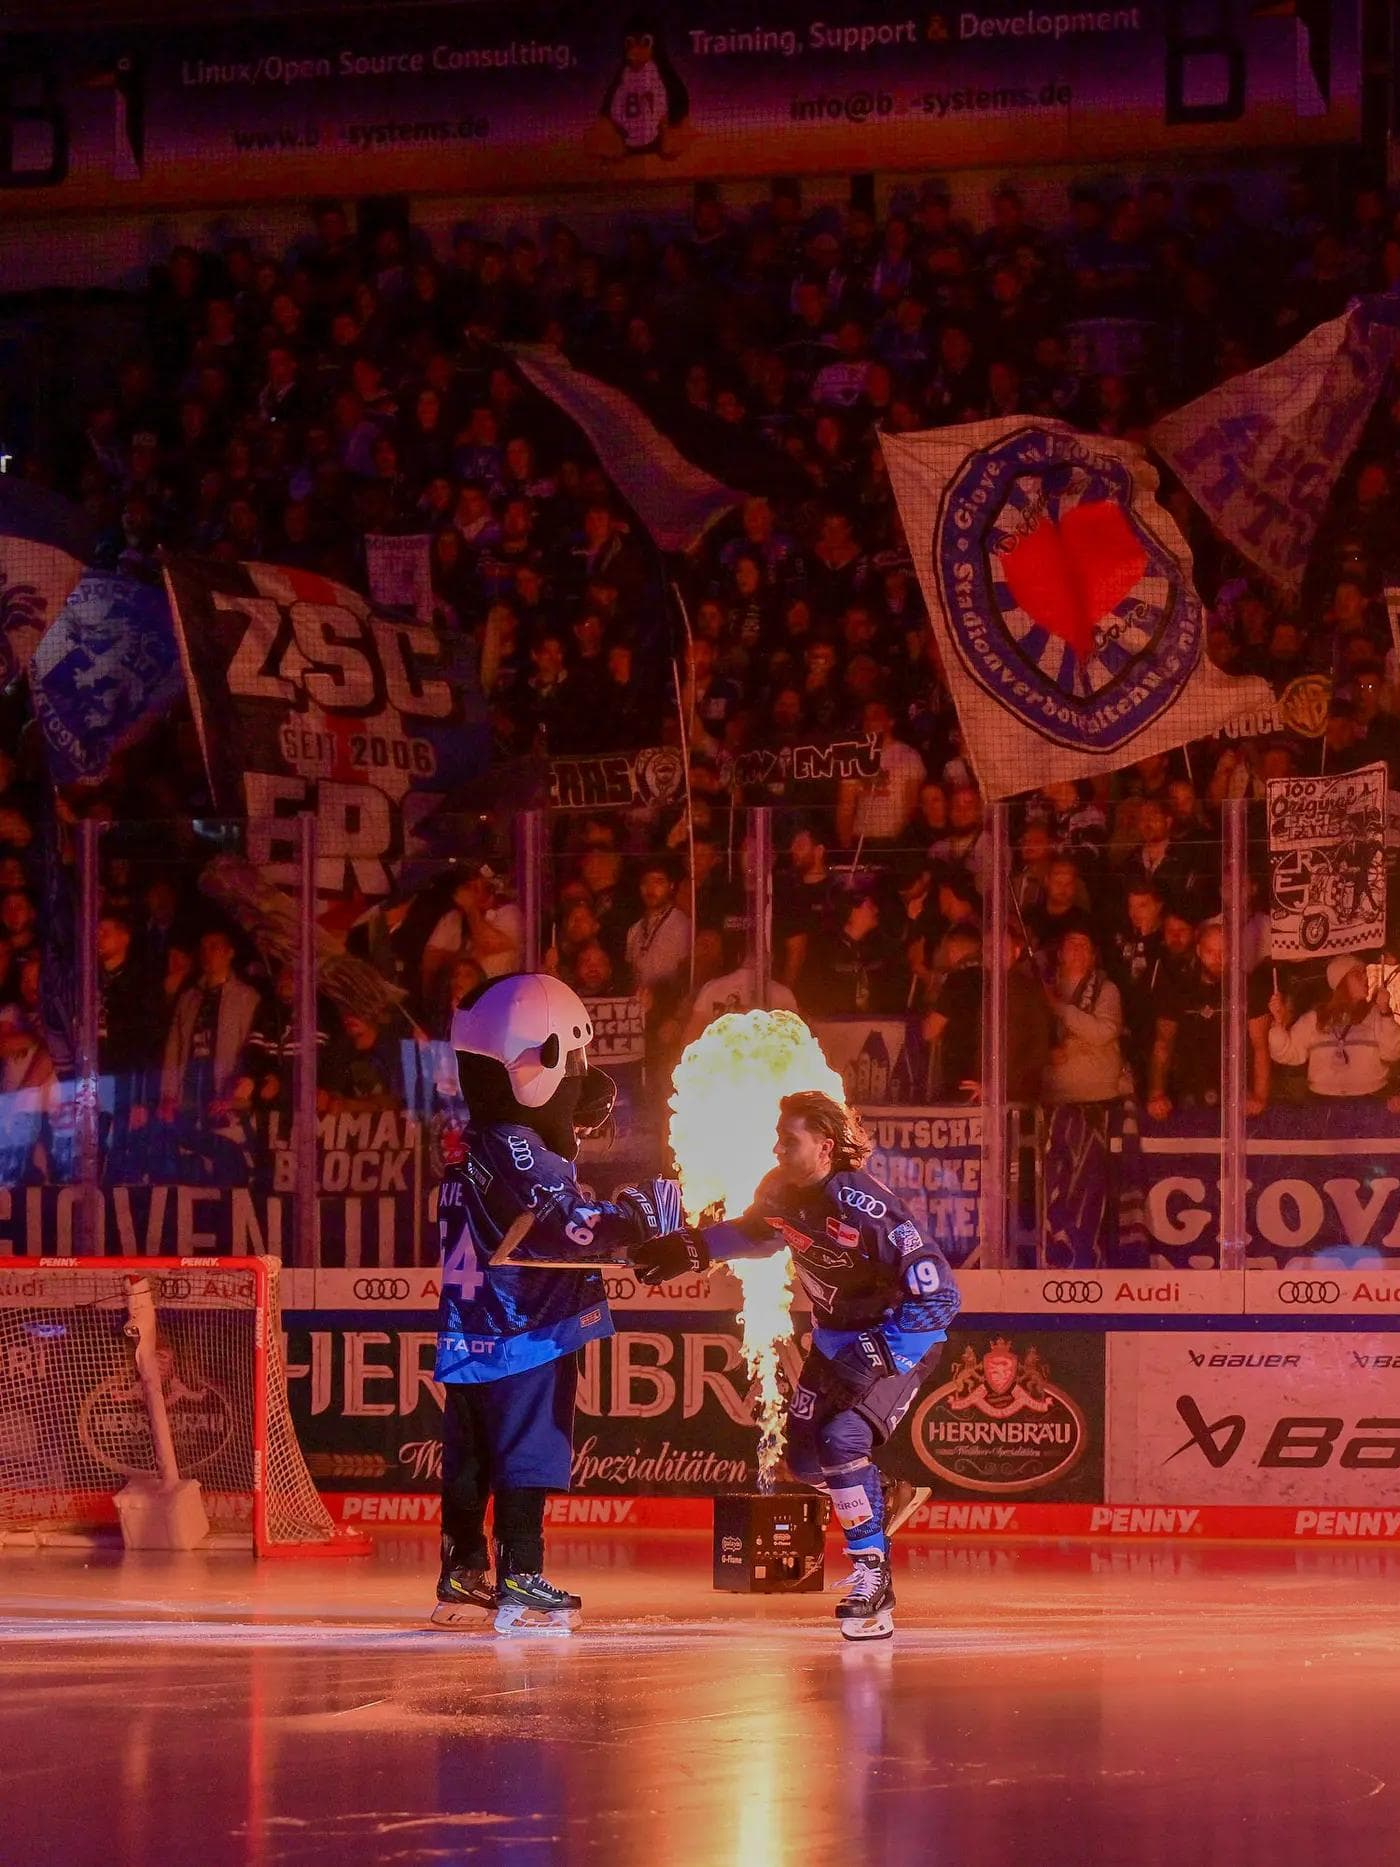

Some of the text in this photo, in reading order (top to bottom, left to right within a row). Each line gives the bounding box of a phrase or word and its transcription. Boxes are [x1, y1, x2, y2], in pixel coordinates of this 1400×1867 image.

[688, 29, 803, 56] Training,
[808, 19, 918, 51] Support
[959, 6, 1142, 39] Development
[181, 38, 578, 86] Linux/Open Source Consulting,
[210, 590, 452, 720] ZSC
[283, 727, 433, 772] SEIT 2006
[273, 1152, 413, 1193] BOCK
[907, 1260, 940, 1295] 19
[1114, 1282, 1181, 1303] Audi
[440, 1336, 497, 1355] TADT
[929, 1420, 1072, 1445] HERRNBRÄU
